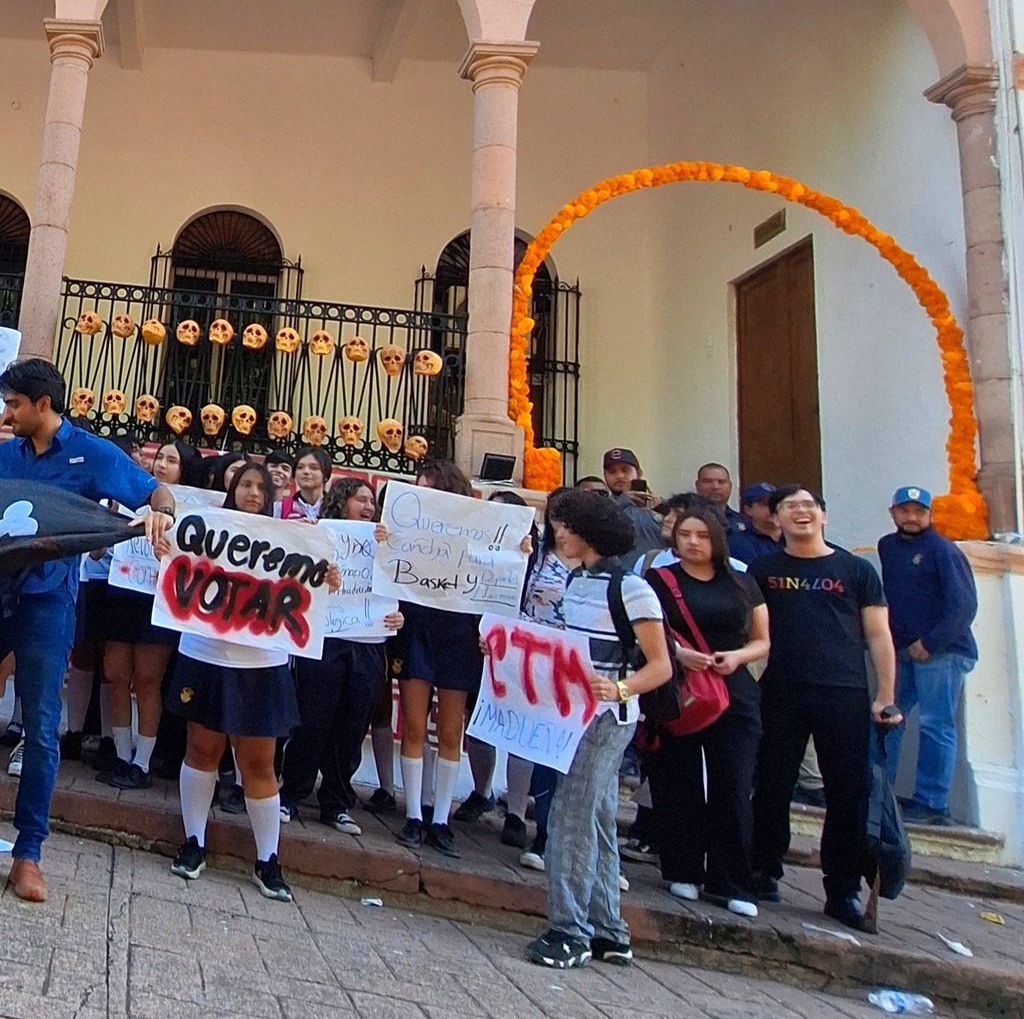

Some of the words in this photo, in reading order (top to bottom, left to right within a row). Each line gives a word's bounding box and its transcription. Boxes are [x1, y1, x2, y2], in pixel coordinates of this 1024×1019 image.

[175, 514, 330, 588] Queremo
[388, 558, 459, 592] Basket
[174, 563, 304, 639] VOTAR
[485, 623, 598, 727] CTM
